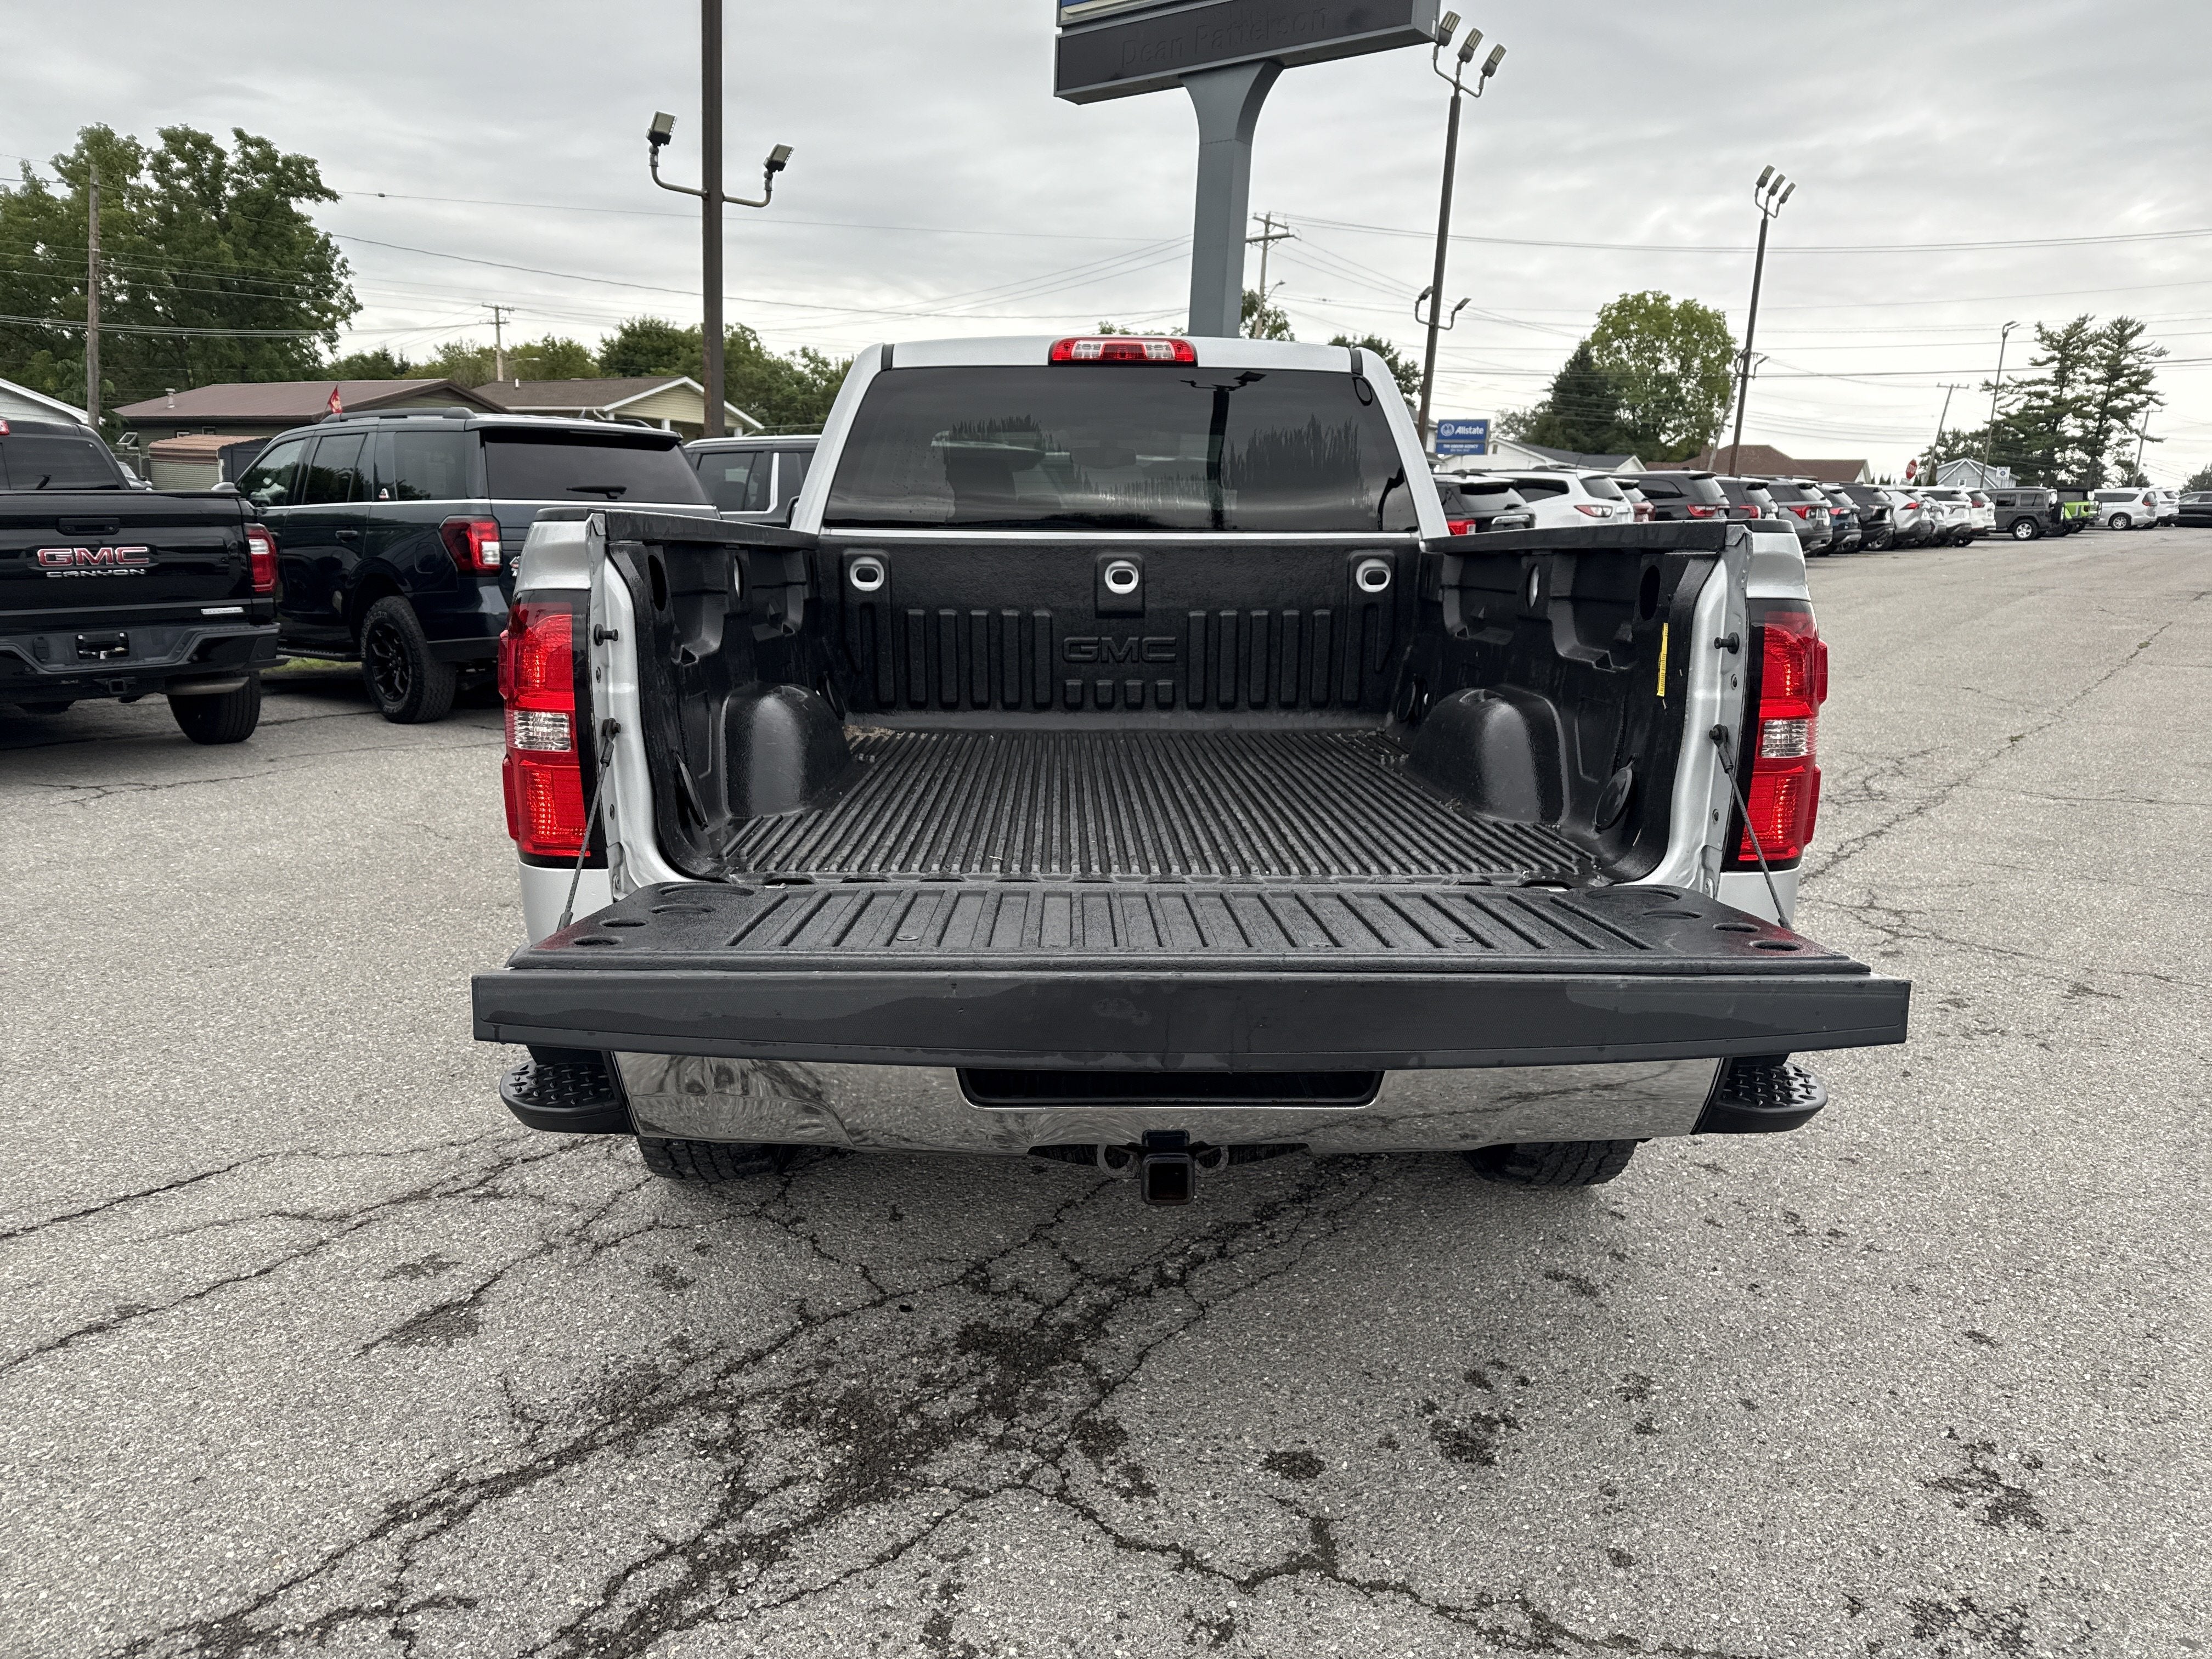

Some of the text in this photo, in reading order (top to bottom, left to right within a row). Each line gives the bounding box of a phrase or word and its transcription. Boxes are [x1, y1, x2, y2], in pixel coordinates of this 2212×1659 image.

[1121, 37, 1183, 68] Dean
[1194, 7, 1328, 55] Patterson
[1454, 426, 1484, 435] Allstate
[1906, 464, 1917, 474] STOP
[37, 546, 149, 567] GMC
[46, 568, 147, 578] CANYON
[1063, 636, 1177, 663] GMC
